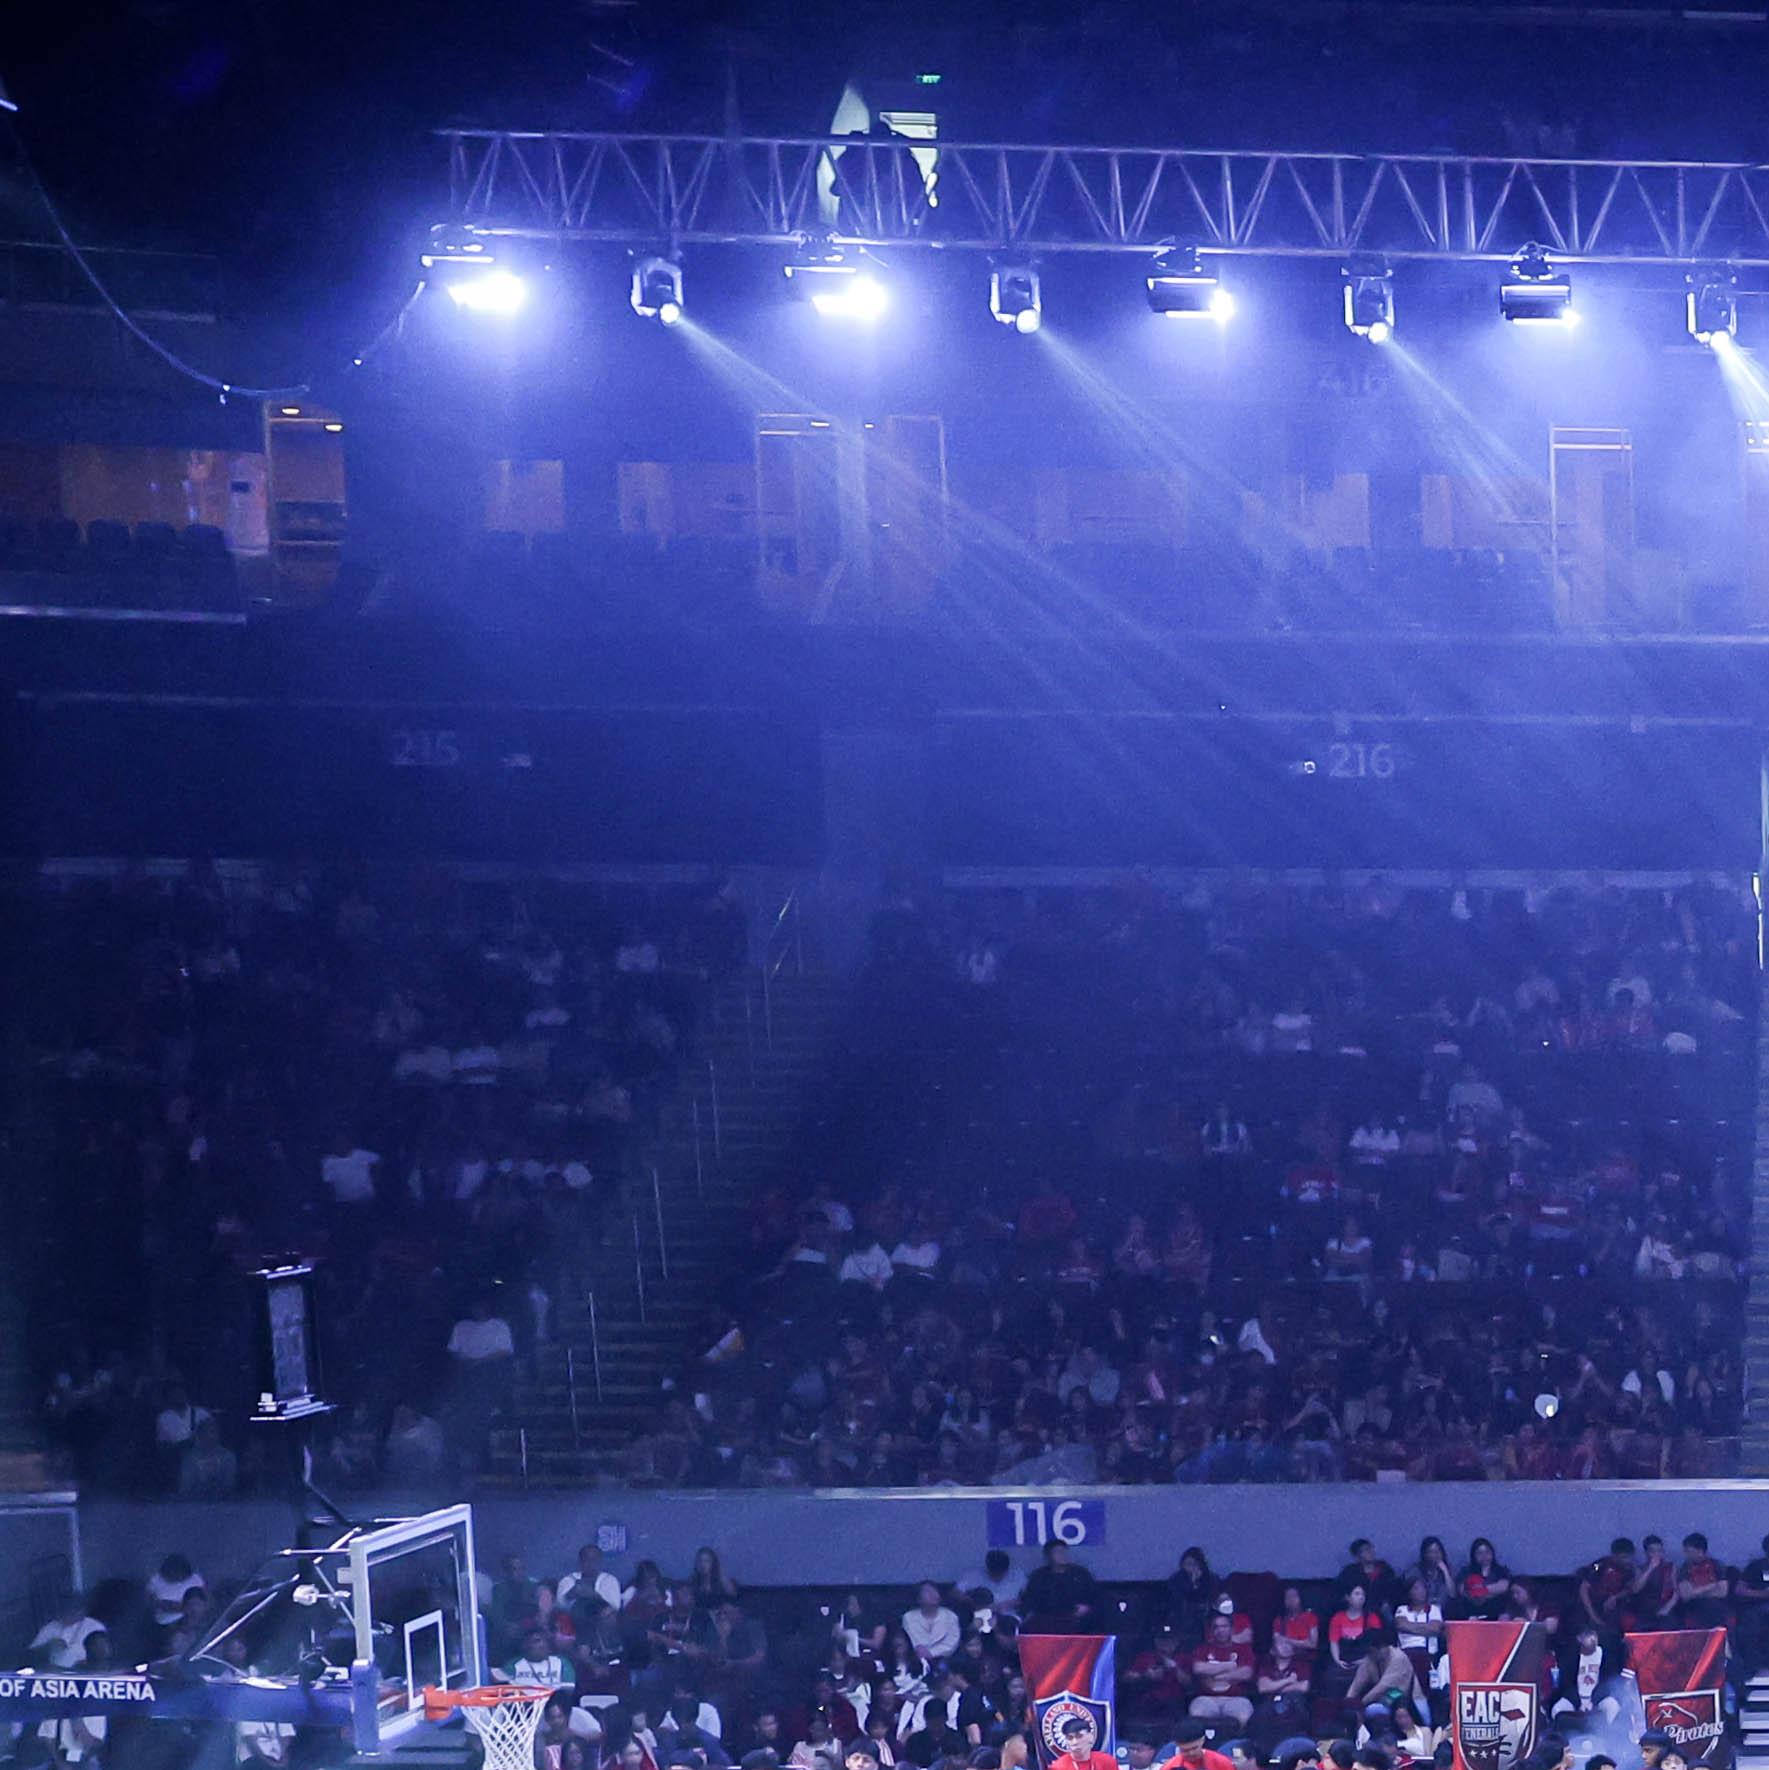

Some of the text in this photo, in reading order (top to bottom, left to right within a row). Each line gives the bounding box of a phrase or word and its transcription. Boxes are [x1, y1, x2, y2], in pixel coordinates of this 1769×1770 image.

[1328, 743, 1395, 778] 216
[1006, 1501, 1087, 1545] 116
[0, 1679, 156, 1702] OF ASIA ARENA
[1461, 1691, 1501, 1723] EAC
